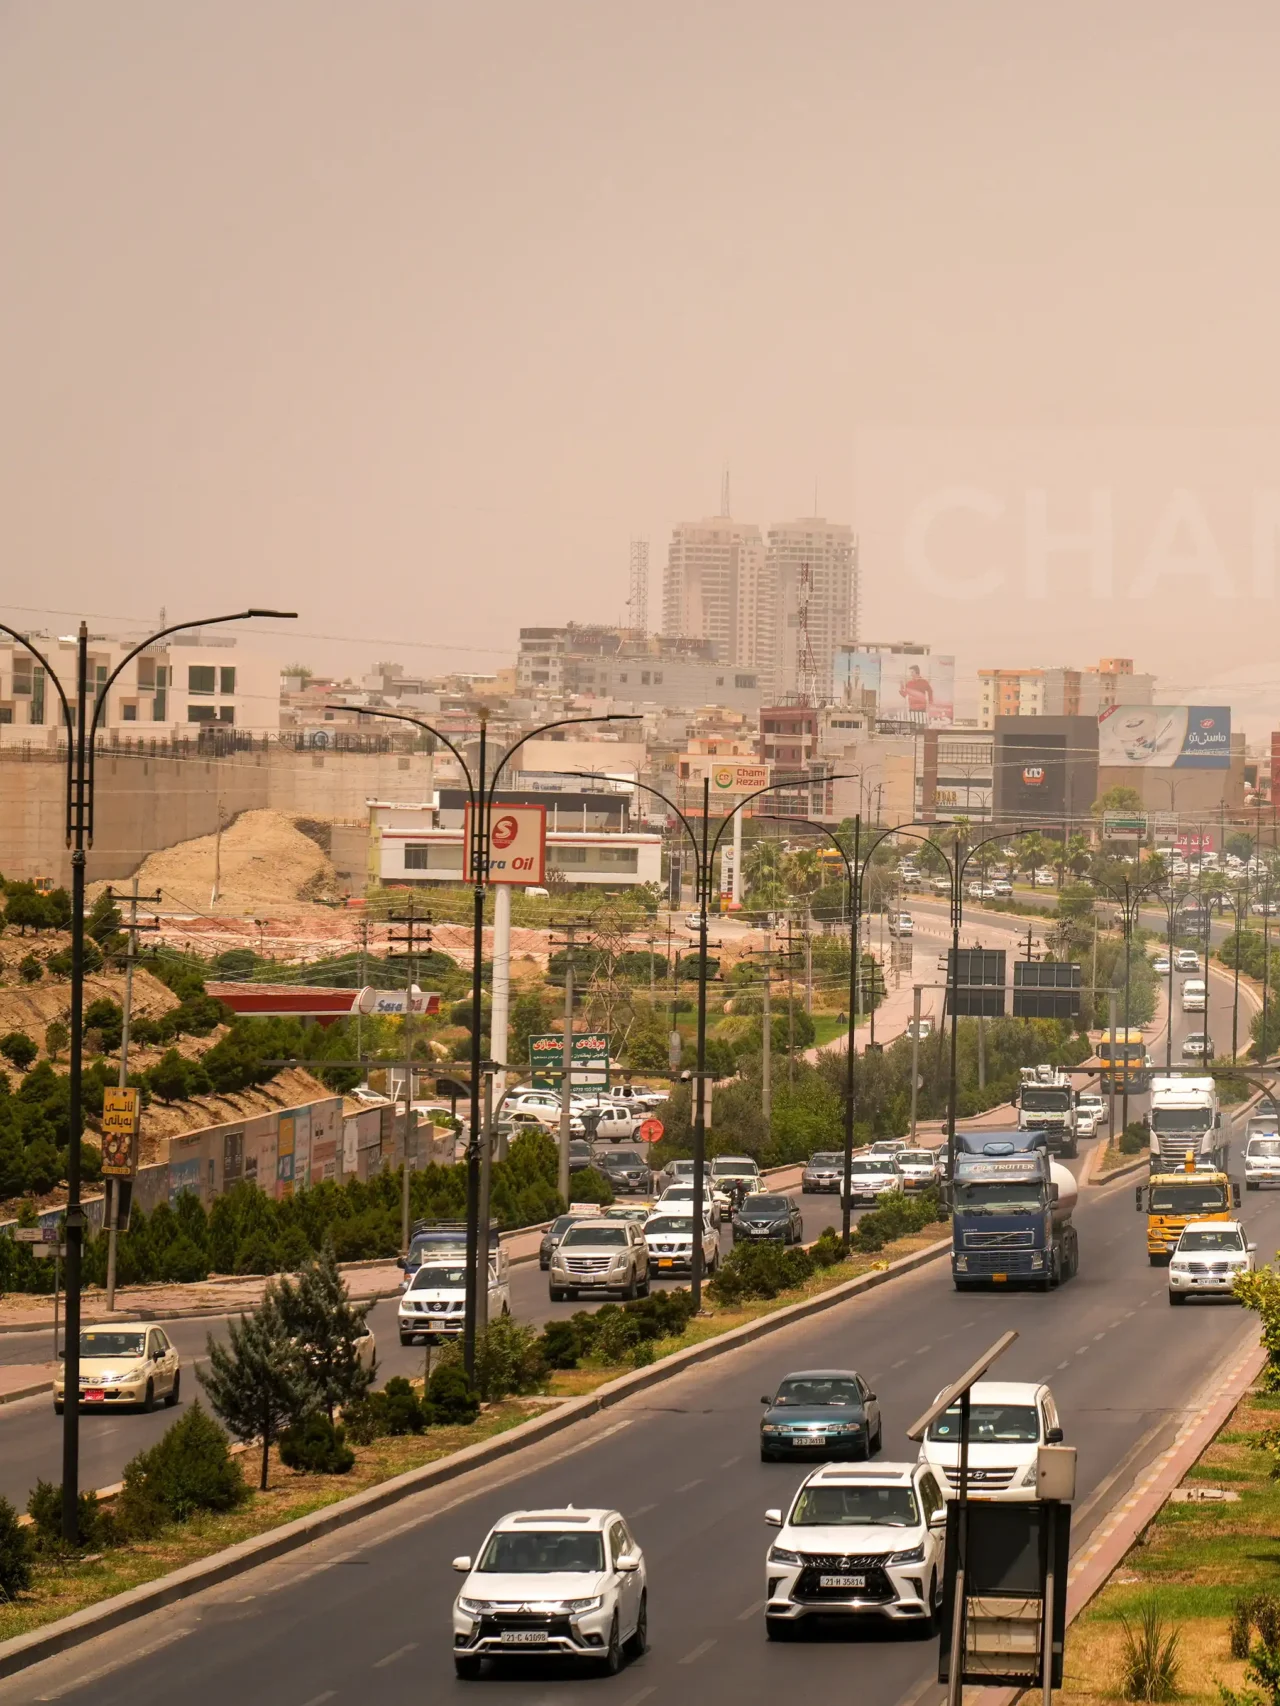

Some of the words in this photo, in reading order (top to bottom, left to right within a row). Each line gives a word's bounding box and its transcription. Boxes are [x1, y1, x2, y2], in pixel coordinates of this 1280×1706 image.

[736, 768, 766, 777] Chami
[736, 779, 766, 787] Rezan
[511, 857, 535, 870] Oil
[377, 999, 403, 1012] Sara
